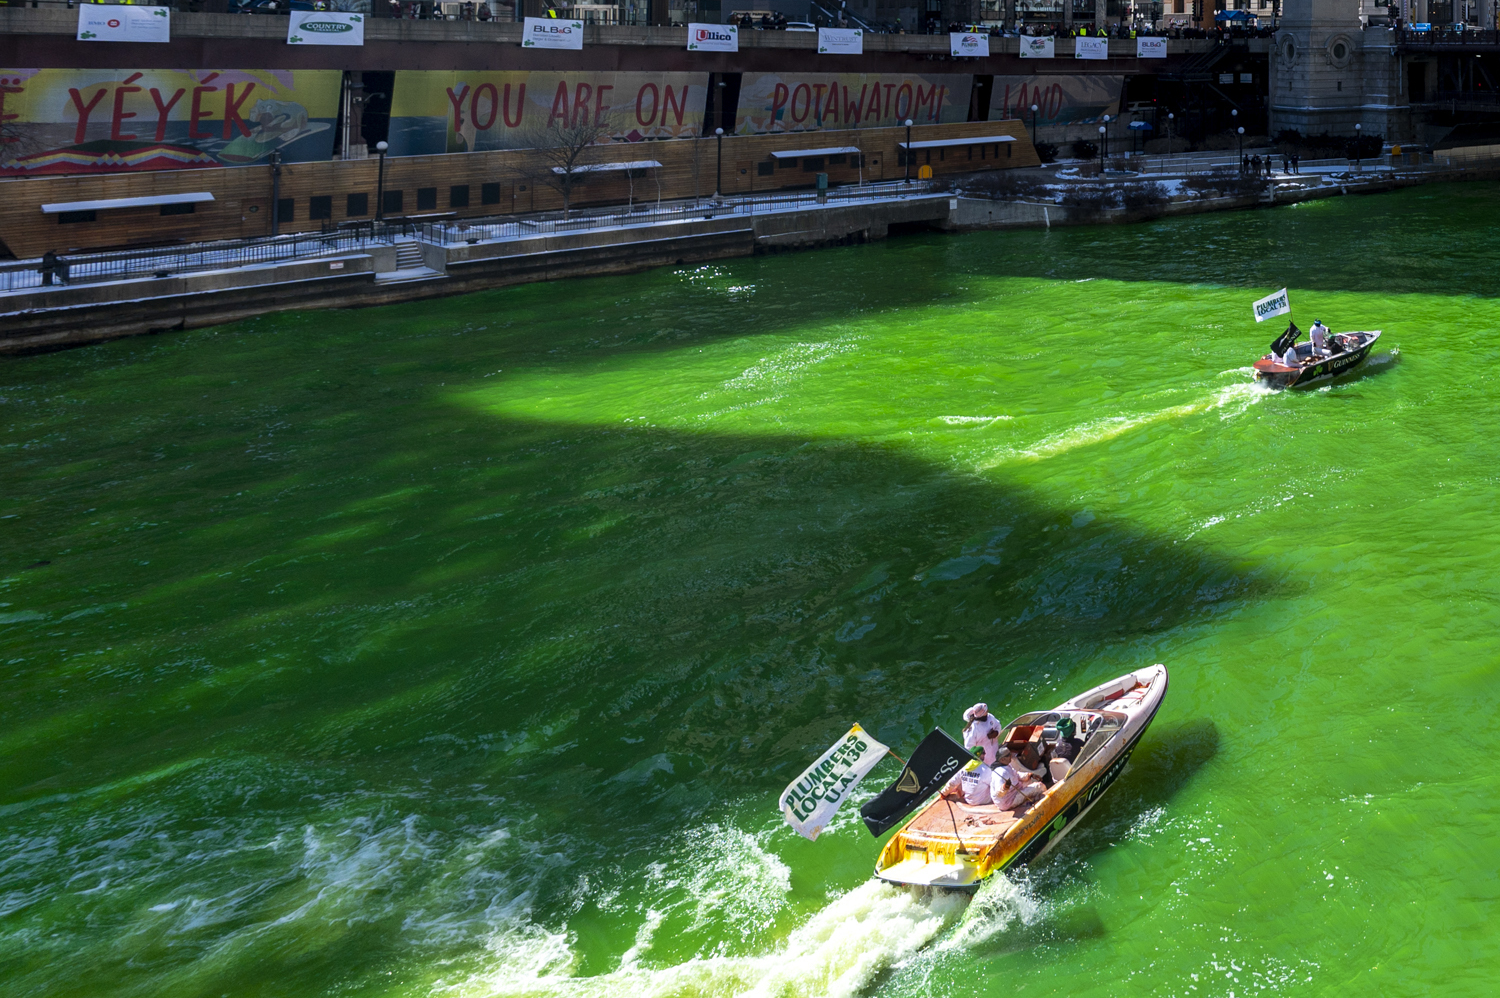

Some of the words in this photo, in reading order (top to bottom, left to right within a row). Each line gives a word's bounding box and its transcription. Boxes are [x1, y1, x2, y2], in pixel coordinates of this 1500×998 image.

[306, 22, 347, 30] COUNTRY
[533, 25, 572, 34] BLB&G
[696, 29, 731, 41] Ullico
[68, 72, 257, 144] YÉYÉK
[446, 82, 527, 133] YOU
[547, 80, 614, 131] ARE
[635, 82, 690, 128] ON
[770, 81, 946, 126] POTAWATOMI
[1001, 82, 1064, 121] LAND
[1258, 305, 1278, 316] LOCAL
[785, 735, 858, 811] PLUMBERS
[793, 772, 843, 823] LOCAL
[841, 741, 867, 767] 130
